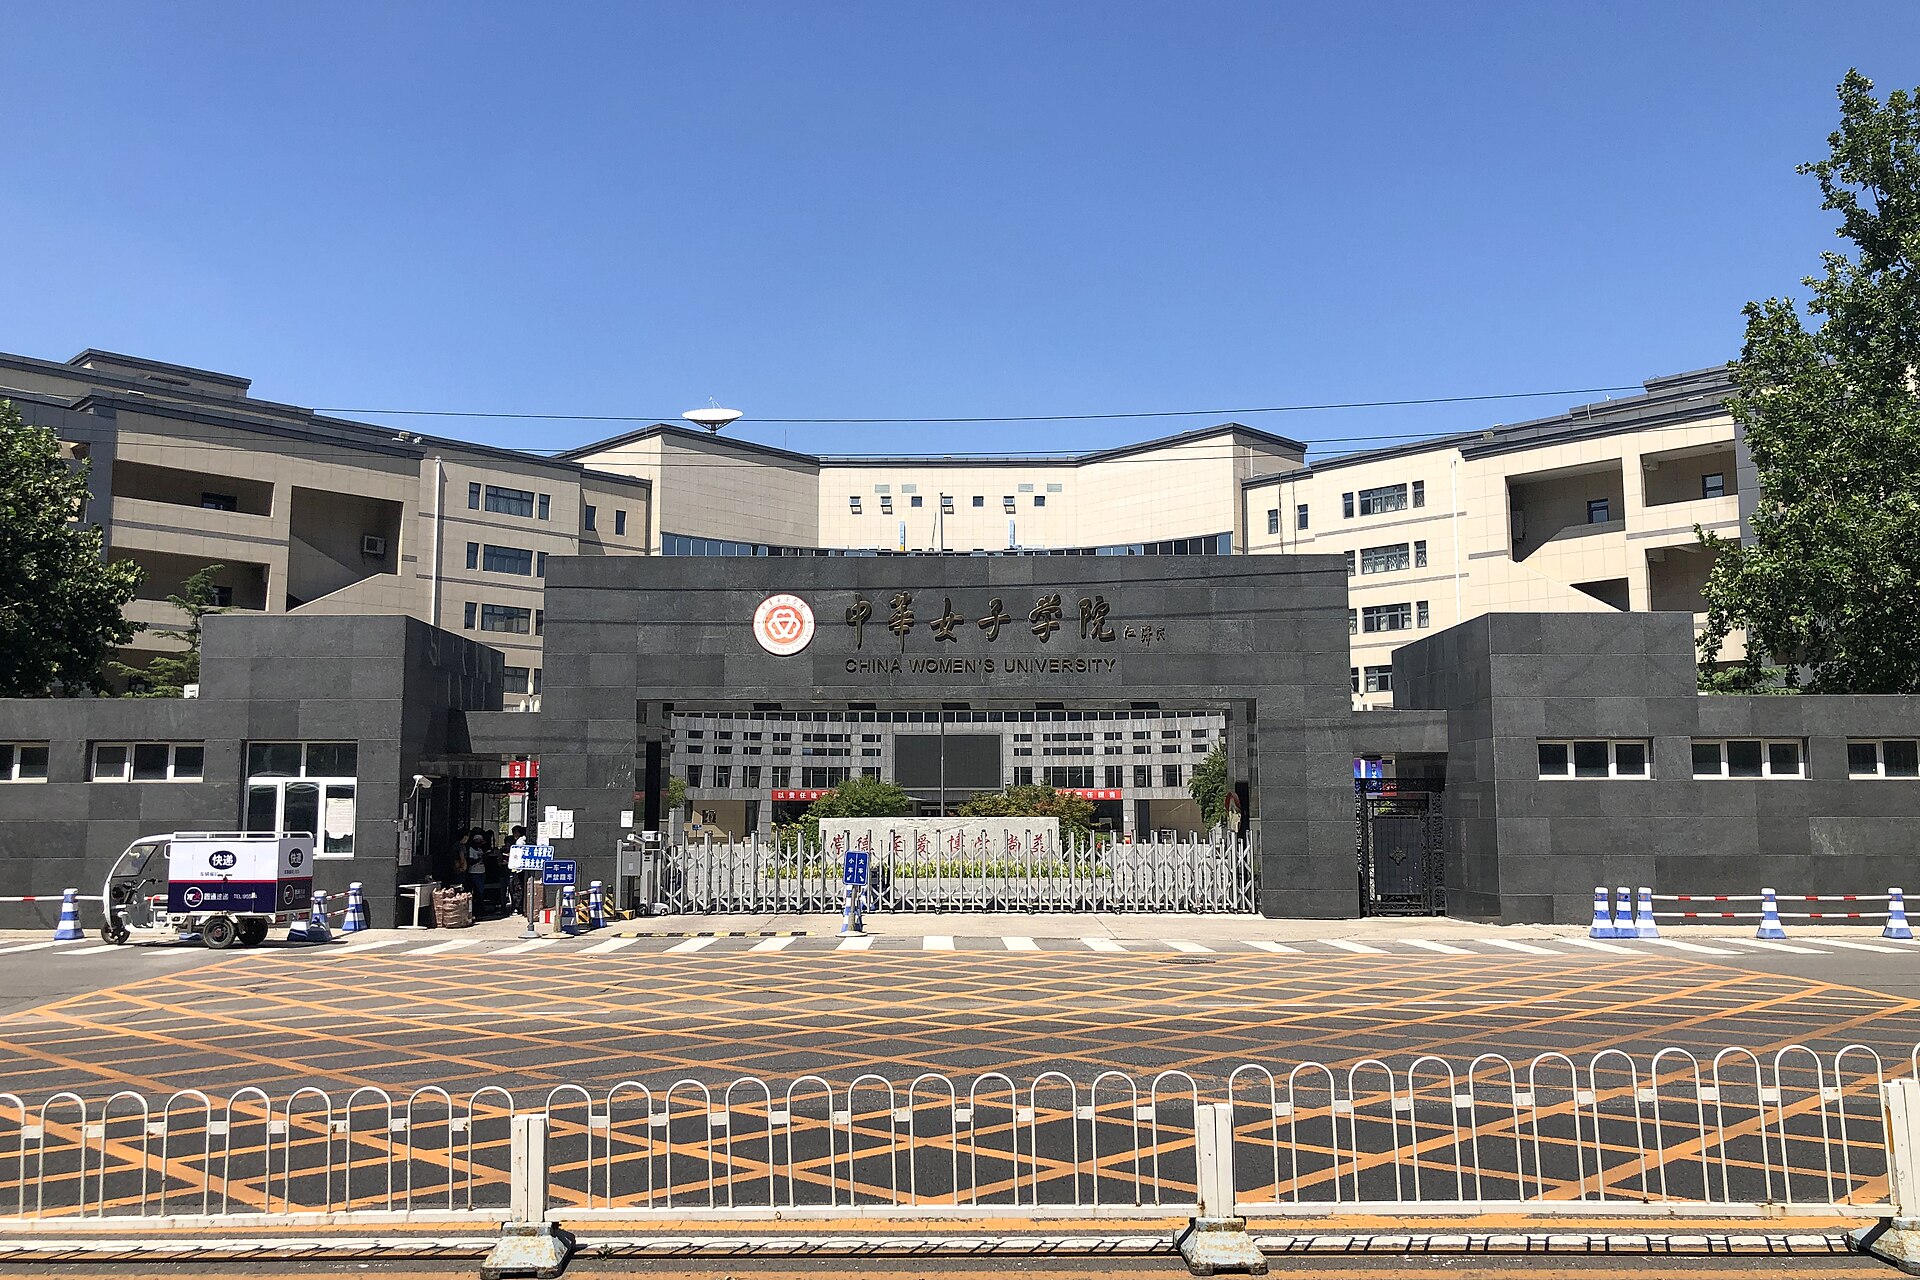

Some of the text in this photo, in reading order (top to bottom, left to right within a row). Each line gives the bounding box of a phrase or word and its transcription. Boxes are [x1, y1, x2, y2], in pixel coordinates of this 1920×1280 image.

[846, 658, 1116, 673] CHINA WOMEN'S UNIVERSITY
[212, 854, 234, 866] 快递
[847, 857, 855, 874] 小车
[858, 858, 865, 874] 大车
